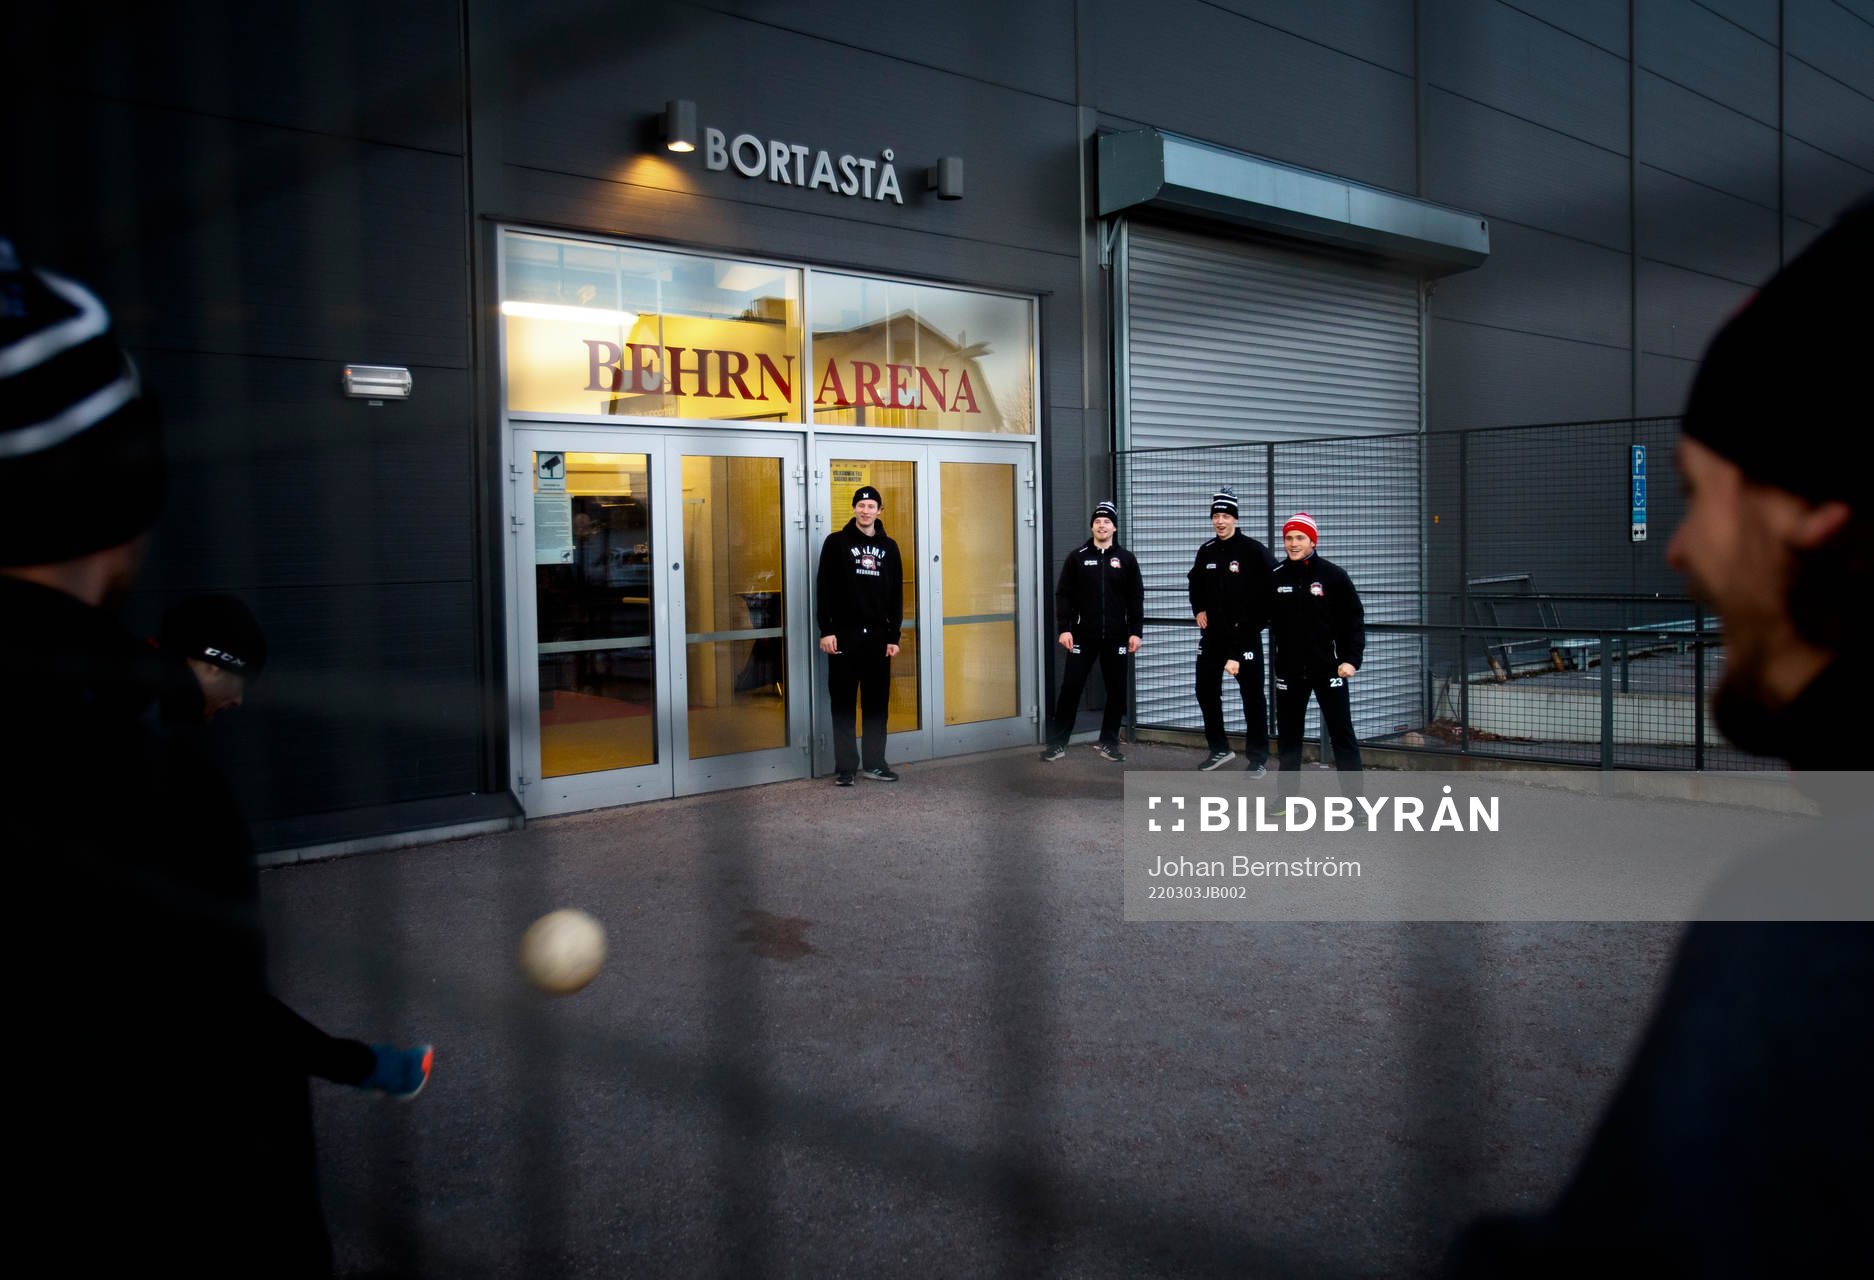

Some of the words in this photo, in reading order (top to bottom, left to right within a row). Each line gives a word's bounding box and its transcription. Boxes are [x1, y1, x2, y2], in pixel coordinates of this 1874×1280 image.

[705, 127, 903, 204] BORTASTÅ
[582, 339, 795, 403] BEHRN
[814, 358, 981, 413] ARENA
[1635, 450, 1644, 474] P
[1243, 651, 1254, 660] 10
[1329, 677, 1343, 688] 23
